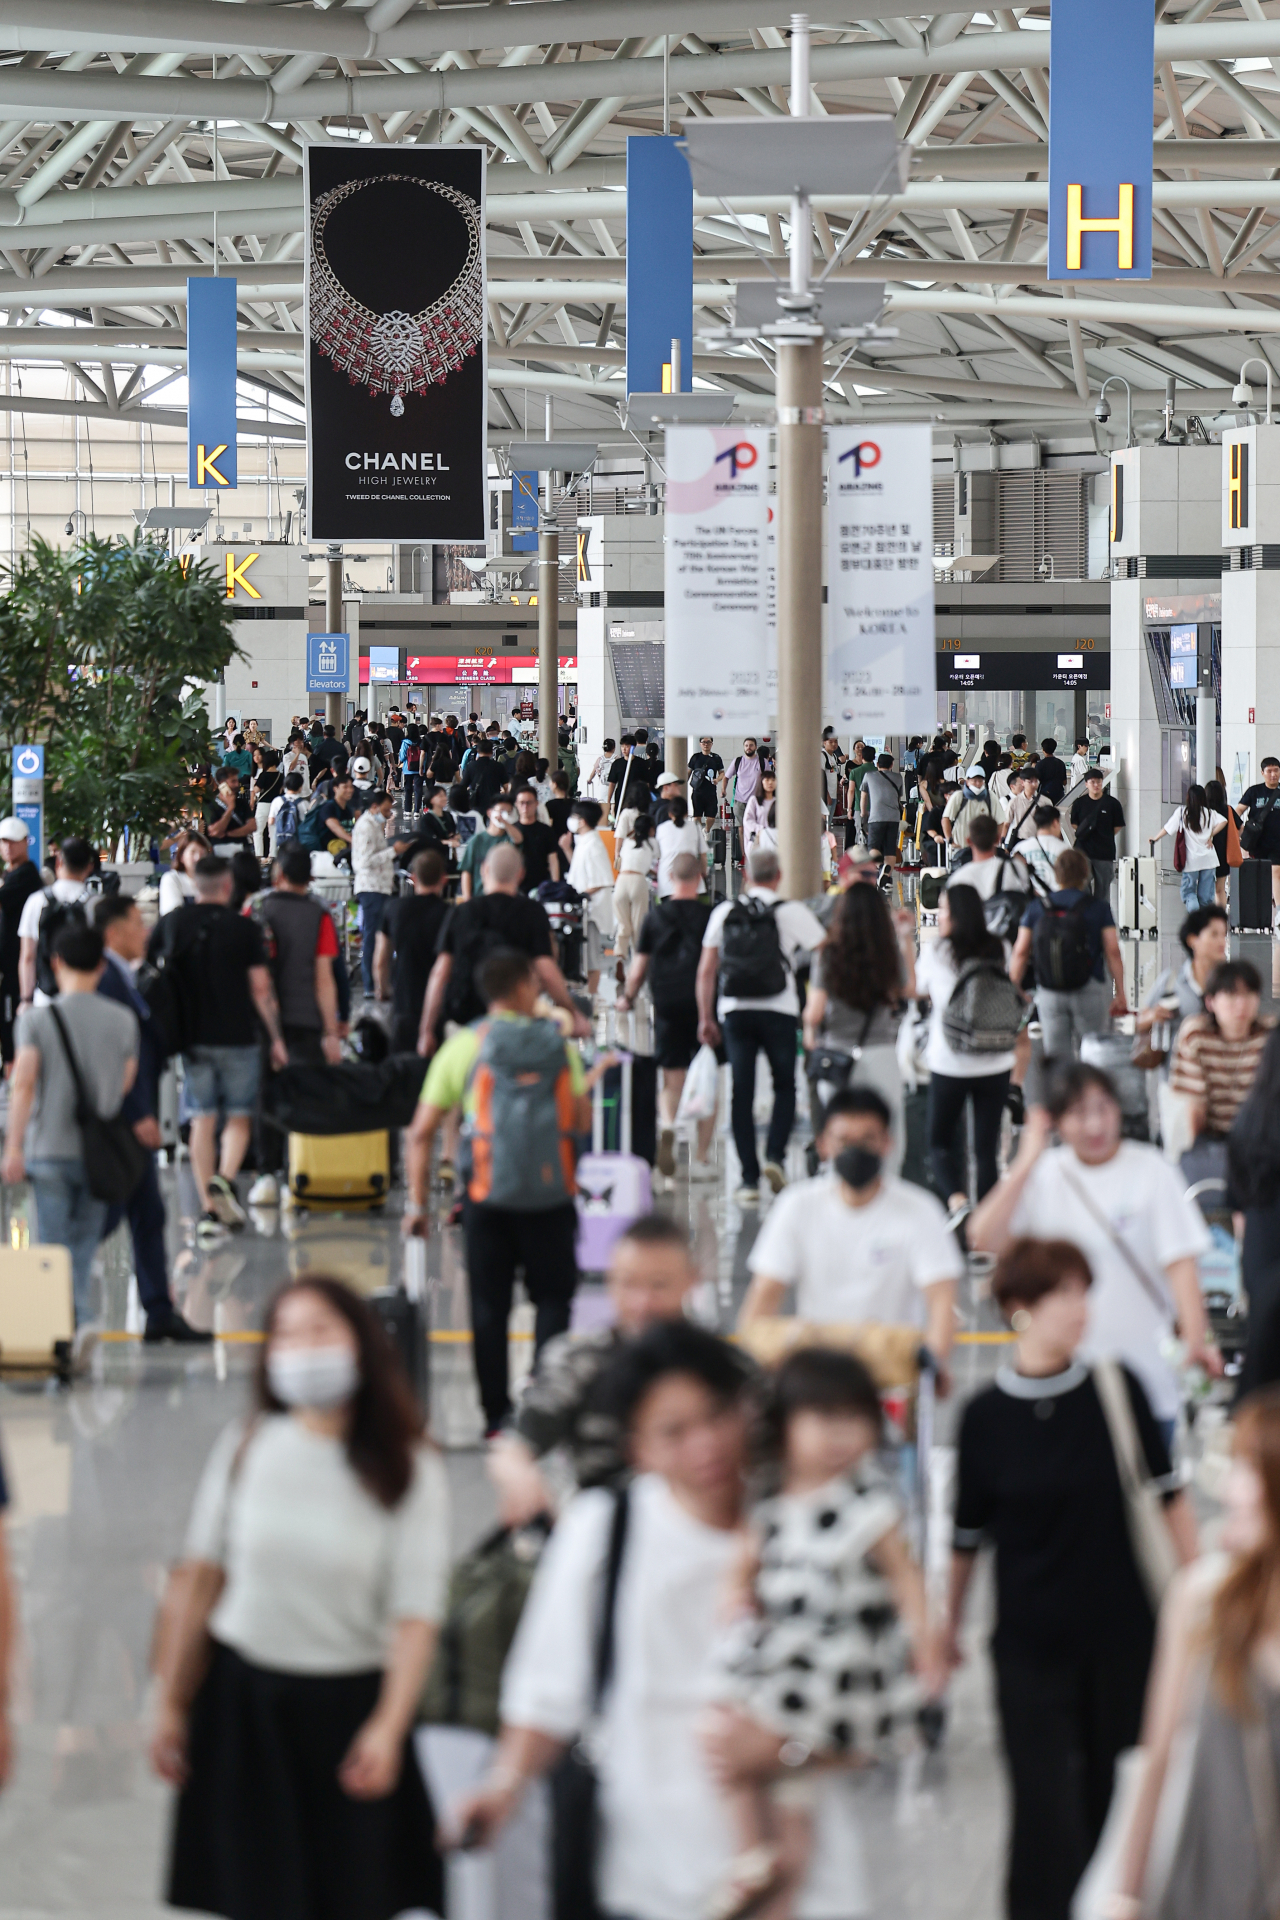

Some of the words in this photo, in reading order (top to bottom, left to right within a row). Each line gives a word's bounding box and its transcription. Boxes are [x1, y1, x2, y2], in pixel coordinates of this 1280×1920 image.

[1066, 183, 1134, 270] H
[197, 444, 230, 485] K
[345, 452, 450, 470] CHANEL
[358, 476, 388, 485] HIGH
[391, 476, 437, 486] JEWELRY
[519, 475, 533, 496] 6
[1229, 443, 1244, 529] H
[577, 533, 589, 582] K
[226, 553, 262, 599] K
[475, 647, 493, 656] K20
[941, 639, 961, 650] J19
[1074, 639, 1095, 650] J20
[309, 679, 346, 688] Elevators
